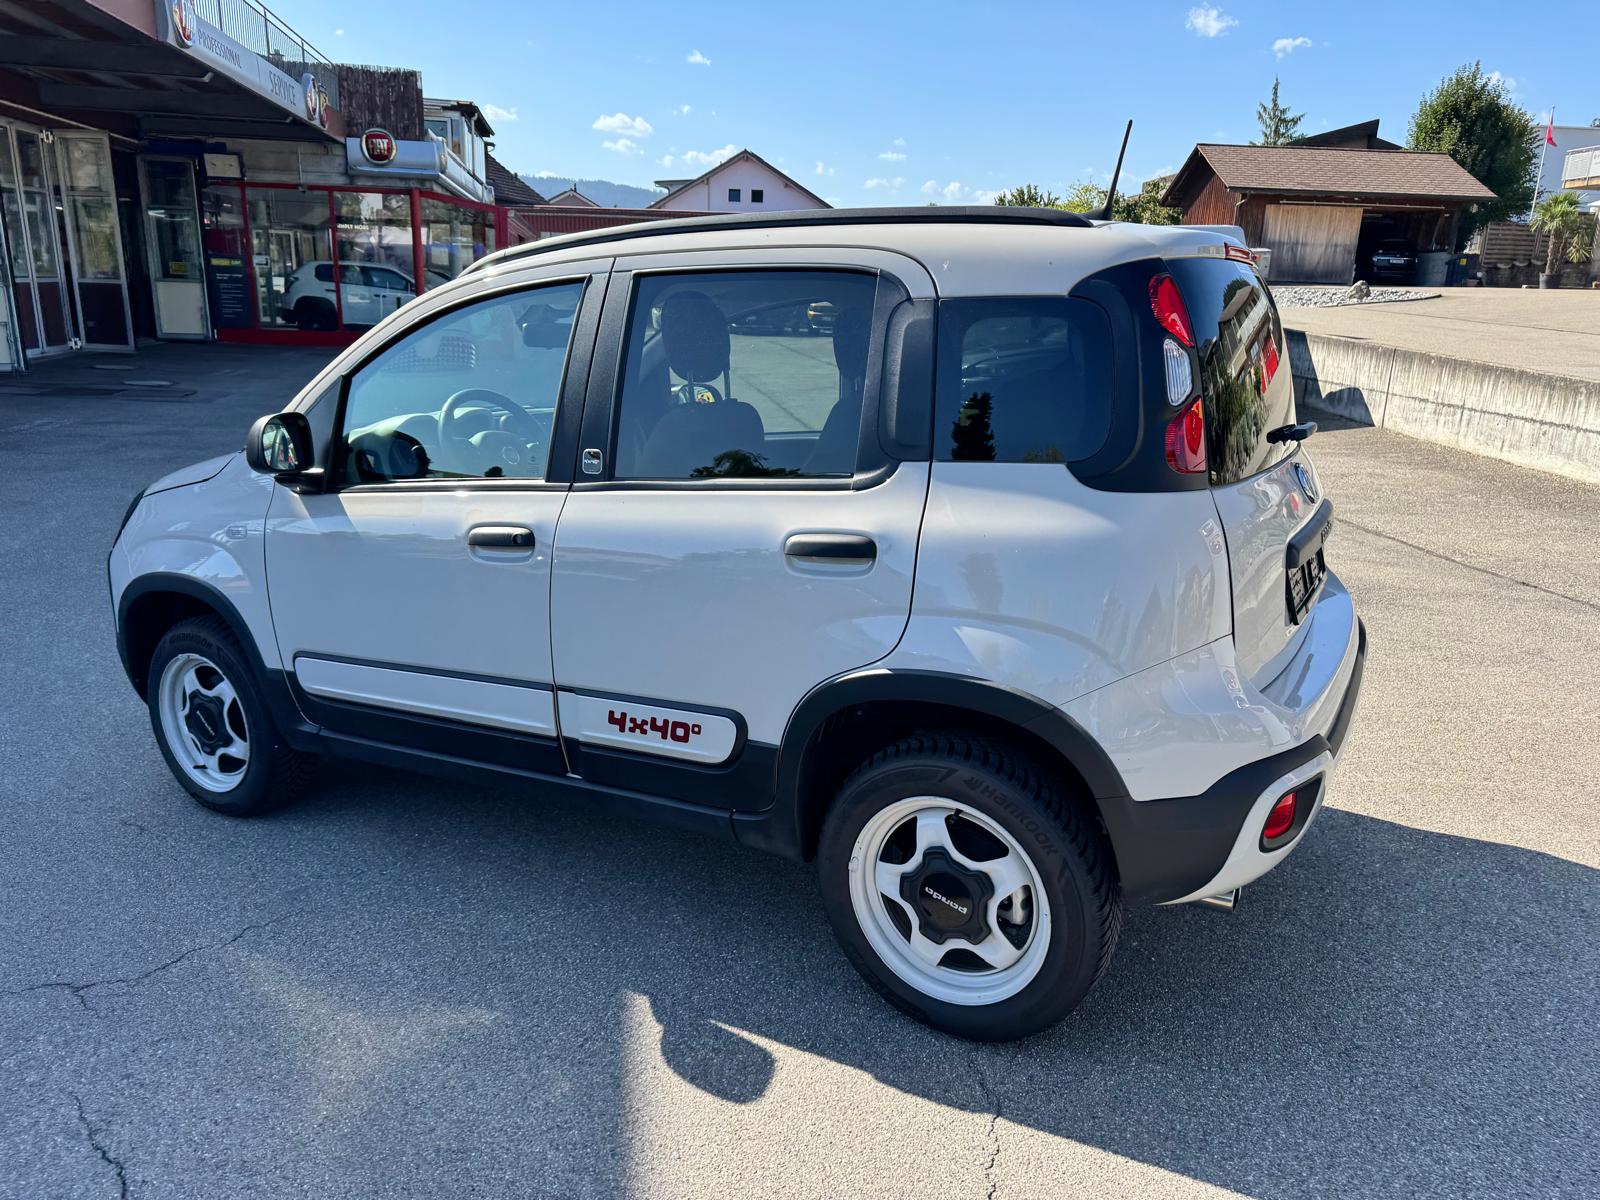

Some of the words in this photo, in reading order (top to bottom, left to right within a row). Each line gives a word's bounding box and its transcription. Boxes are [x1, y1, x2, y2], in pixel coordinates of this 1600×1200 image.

[198, 29, 241, 69] PROFESSIONAL
[269, 70, 297, 106] SERVICE
[367, 138, 389, 155] FIAT
